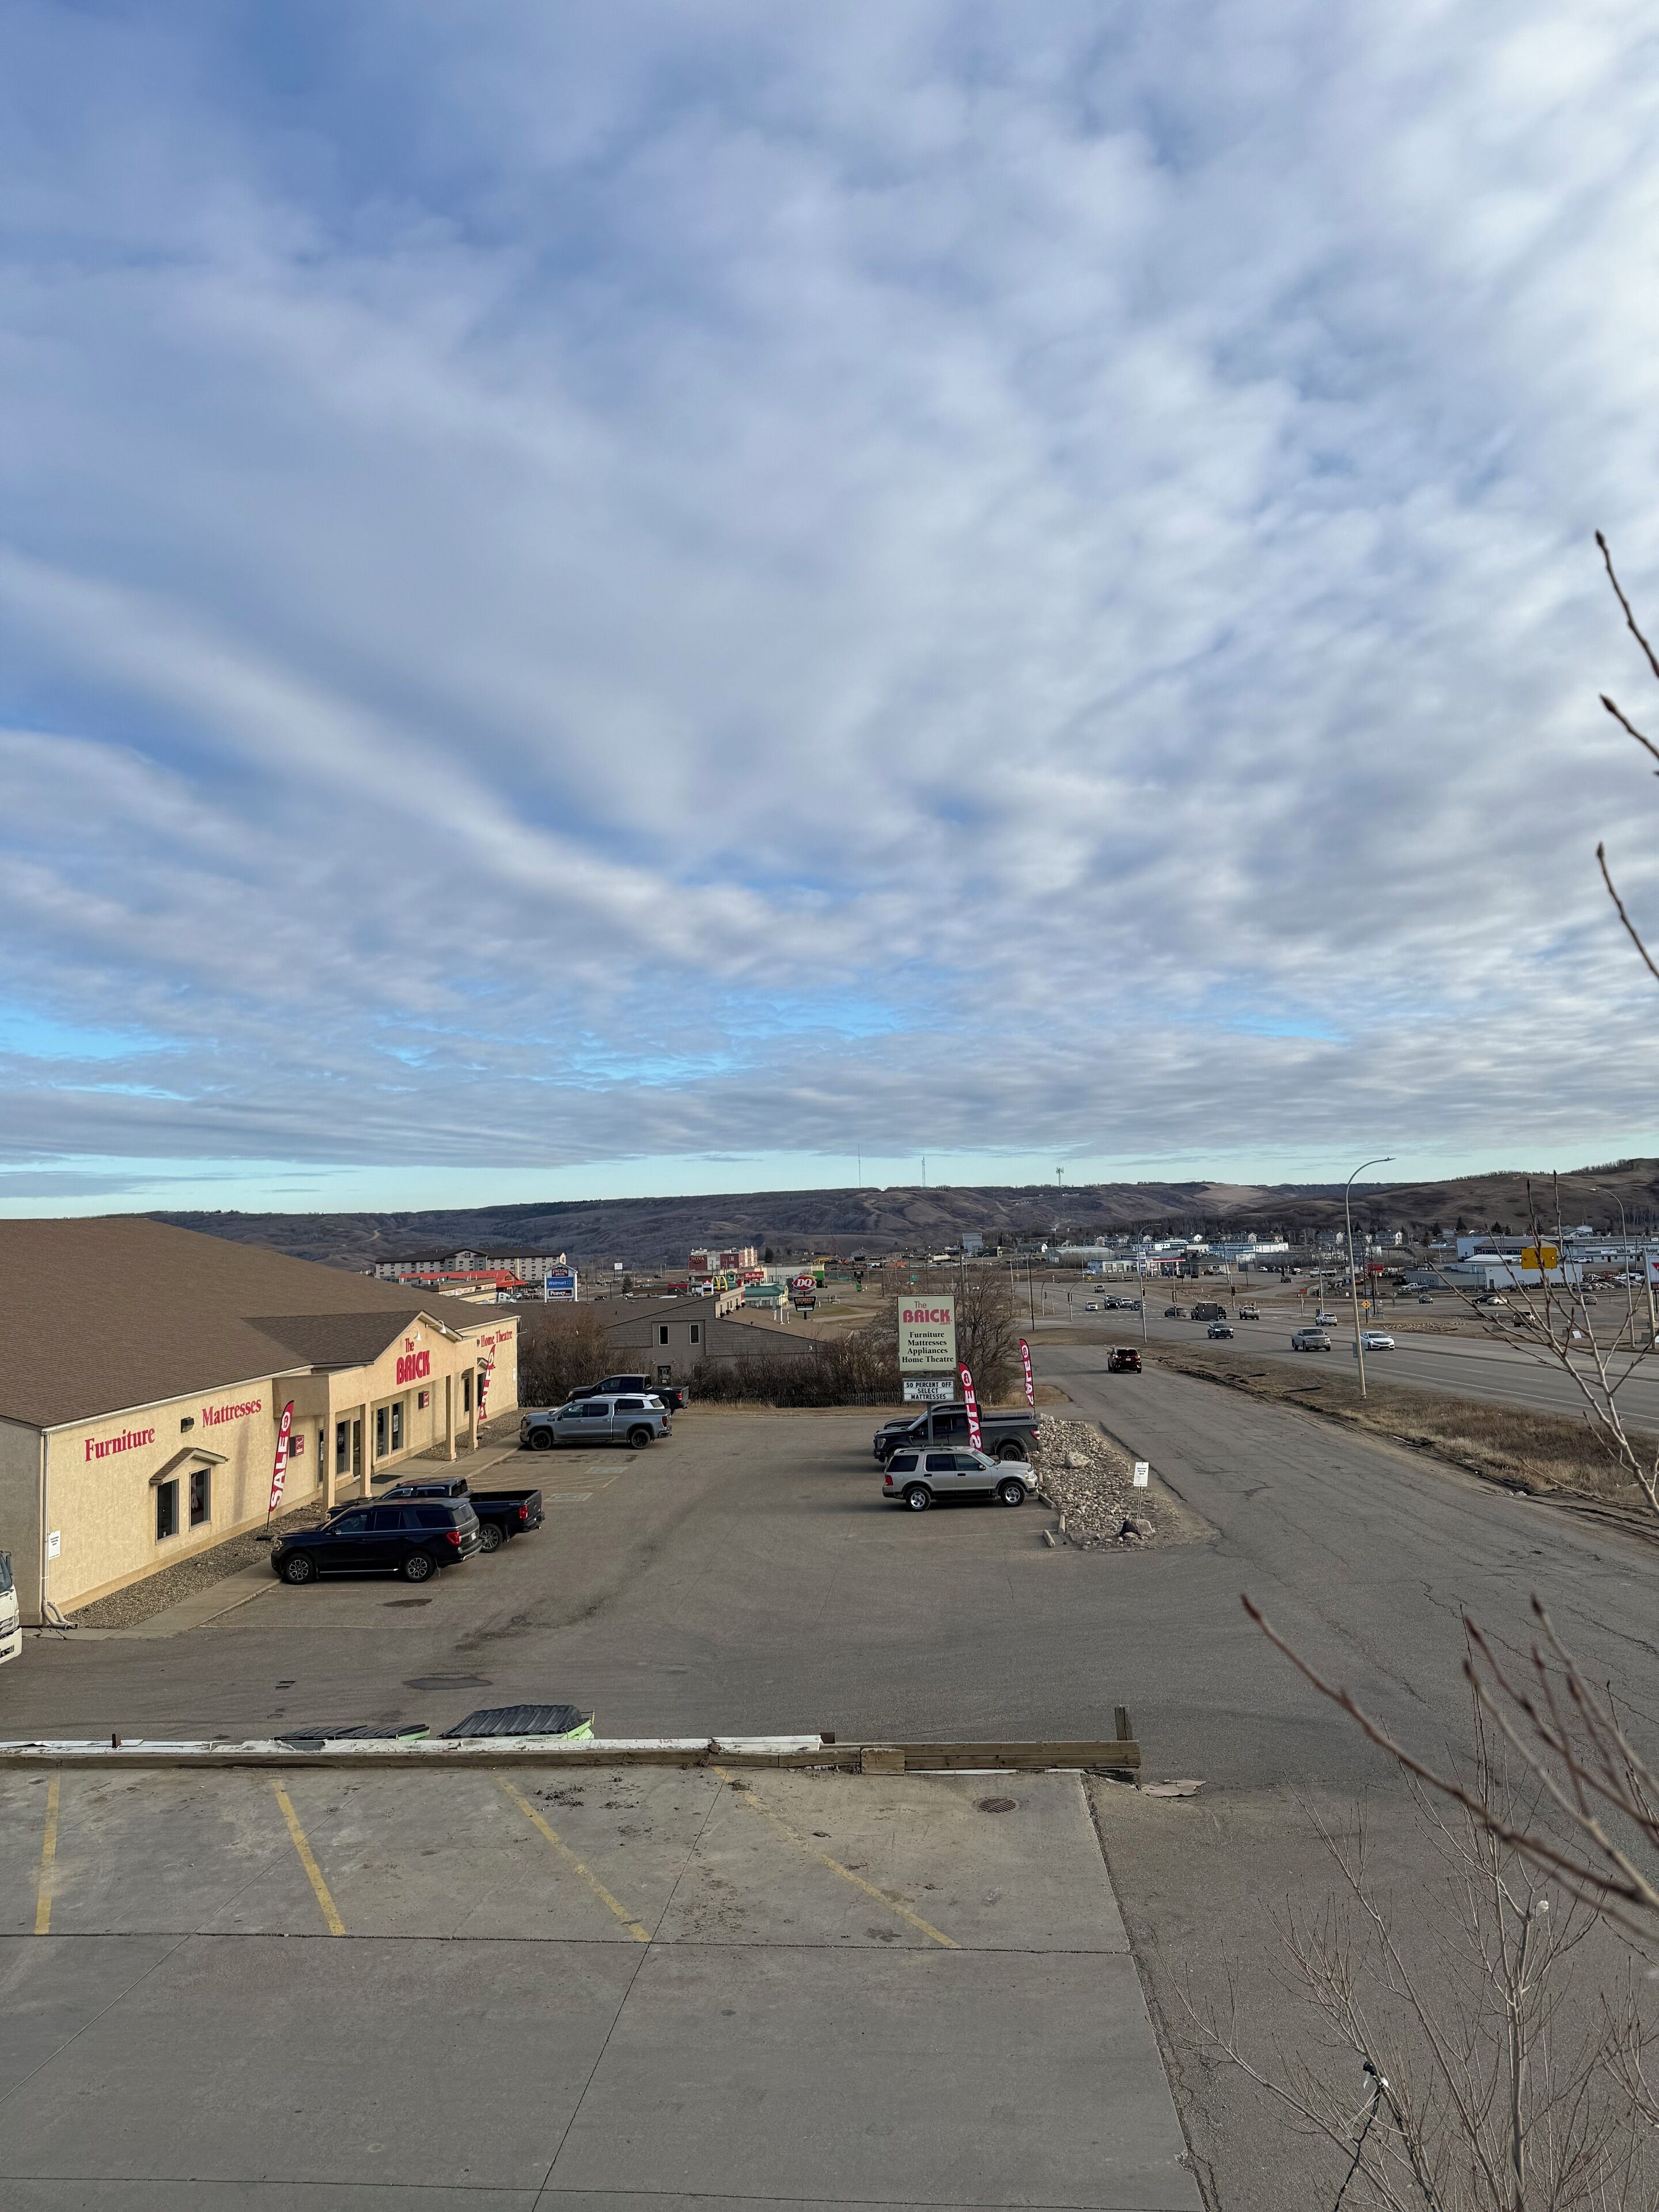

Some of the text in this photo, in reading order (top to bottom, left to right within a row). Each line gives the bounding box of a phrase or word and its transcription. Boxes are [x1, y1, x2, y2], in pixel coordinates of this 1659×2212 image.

[797, 1279, 812, 1287] DQ
[903, 1309, 950, 1323] BRICK
[405, 1338, 414, 1353] The
[481, 1330, 513, 1347] Home Theatre
[907, 1347, 948, 1355] Appliances
[396, 1350, 430, 1385] BRICK
[202, 1399, 262, 1427] Mattresses
[85, 1428, 156, 1462] Furniture
[271, 1436, 288, 1508] SALE
